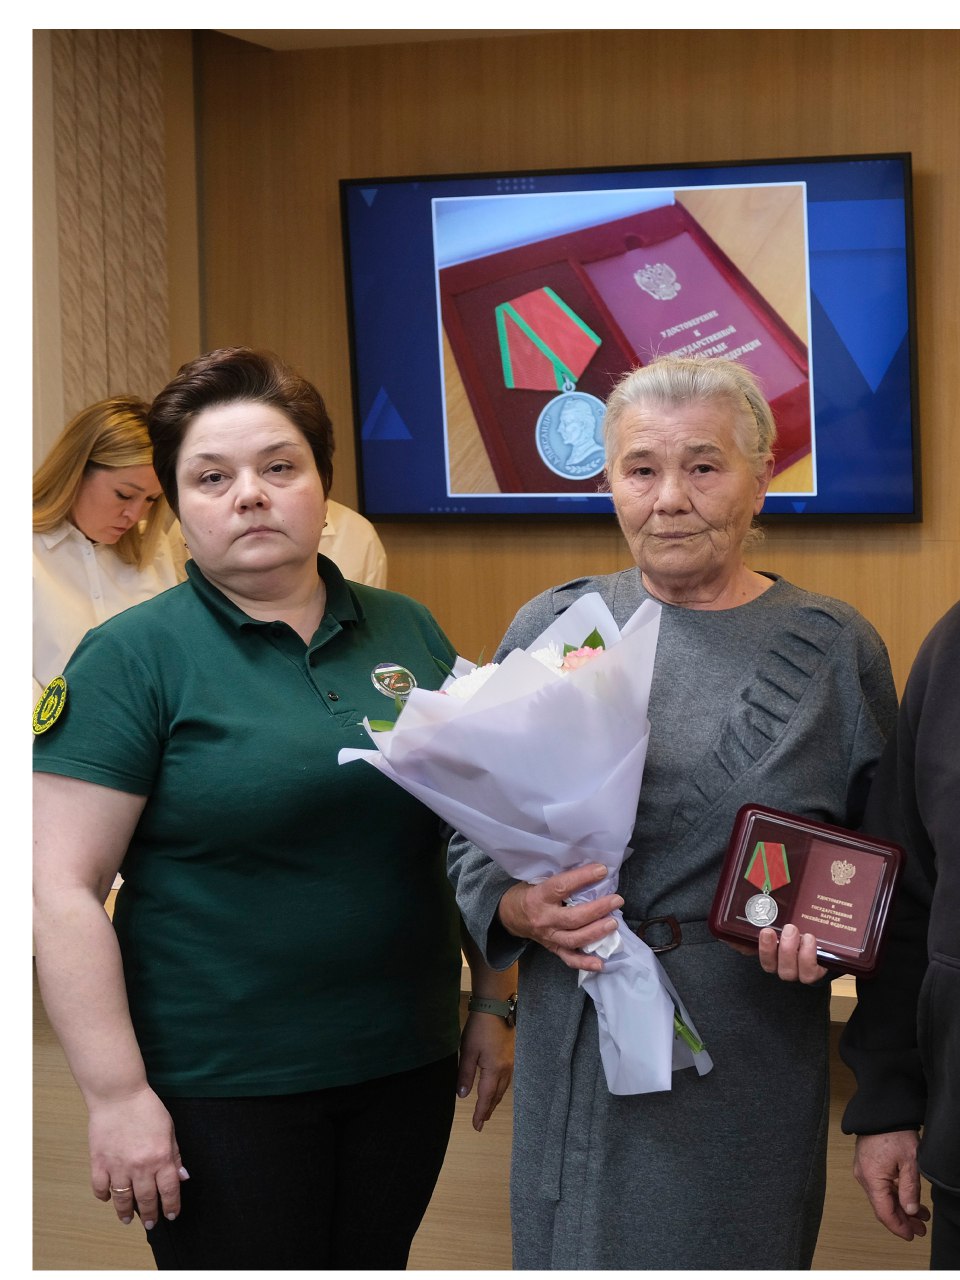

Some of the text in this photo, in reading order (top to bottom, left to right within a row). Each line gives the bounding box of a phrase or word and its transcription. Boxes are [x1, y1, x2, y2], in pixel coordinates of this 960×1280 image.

[660, 309, 719, 338] УДОСТОВЕРЕНИЕ
[693, 329, 701, 337] К
[669, 324, 737, 358] ОСУДАРСТВЕННОЙ
[698, 342, 728, 358] АГРАДЕ
